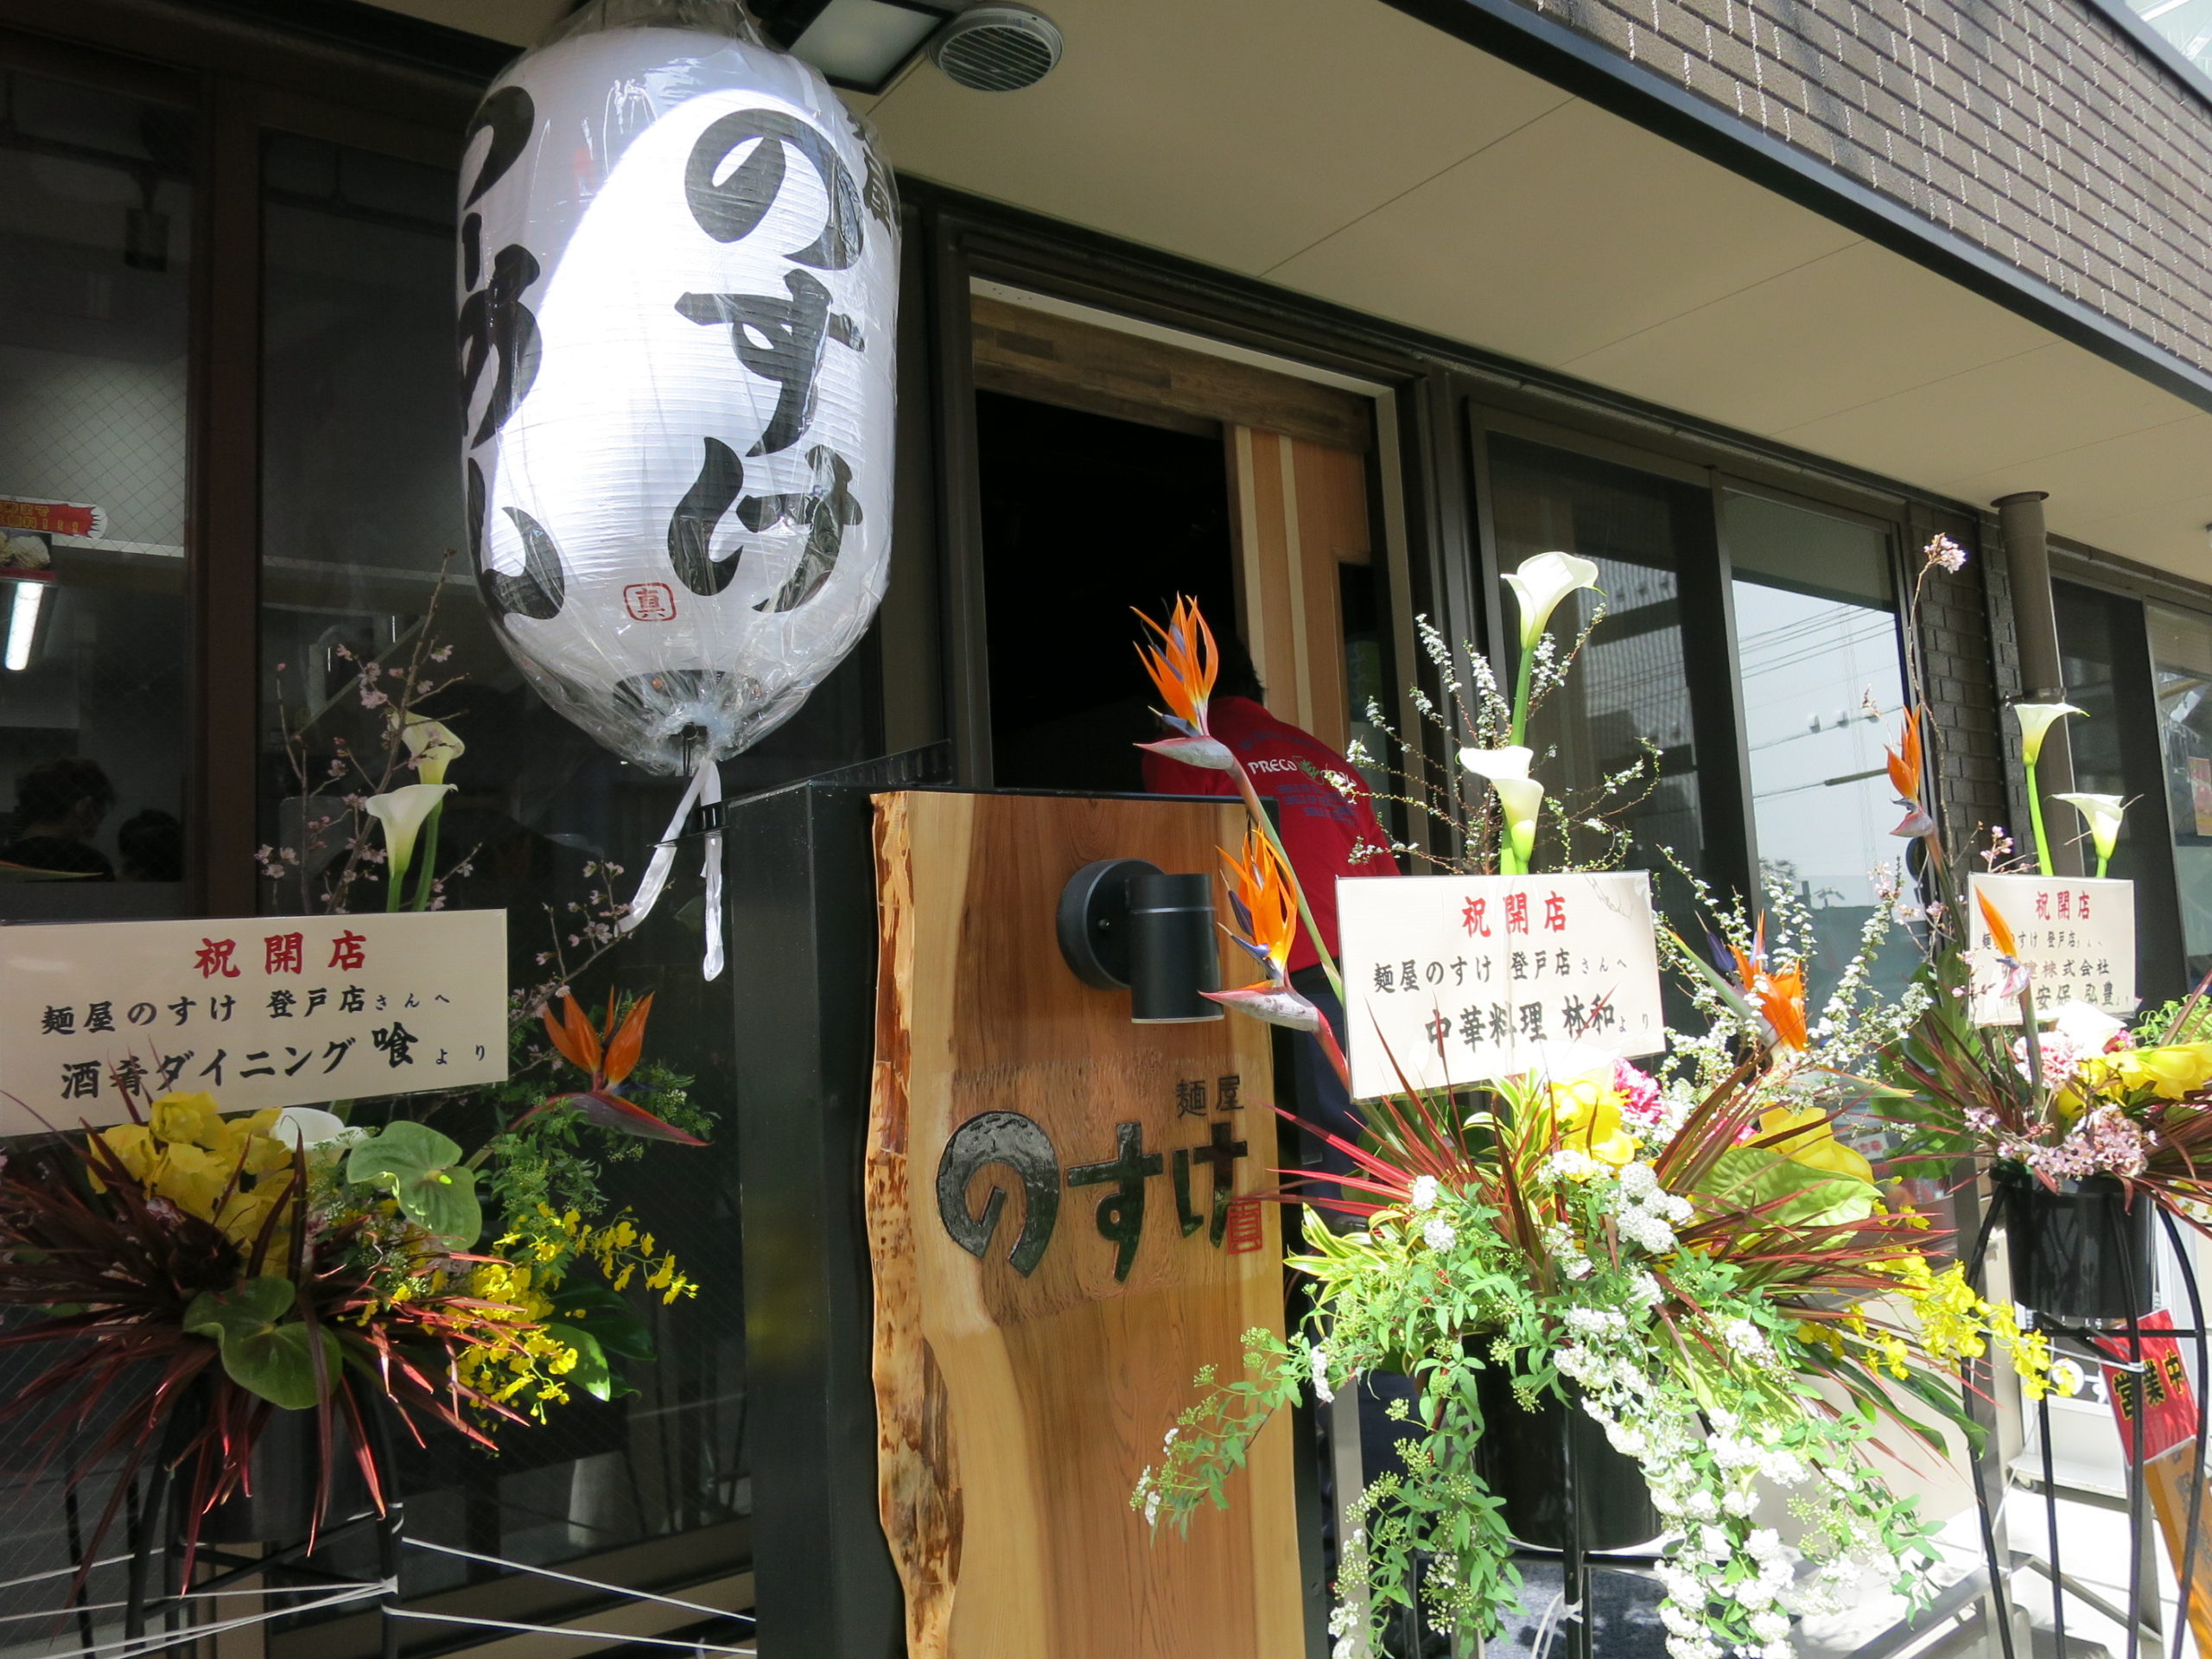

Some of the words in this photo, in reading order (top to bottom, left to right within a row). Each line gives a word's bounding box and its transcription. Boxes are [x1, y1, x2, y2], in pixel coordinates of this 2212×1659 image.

[667, 108, 865, 613] のすけ
[1461, 890, 1567, 938] 祝開店
[2035, 890, 2091, 921] 祝開店
[194, 929, 367, 979] 祝開店
[1372, 955, 1492, 993] 麺屋のすけ
[41, 995, 236, 1035] 麺屋のすけ
[1425, 1000, 1548, 1053] 中華料理
[61, 1036, 356, 1099] 酒肴ダイニング
[1176, 1075, 1244, 1118] 麺屋
[937, 1110, 1248, 1283] のすけ
